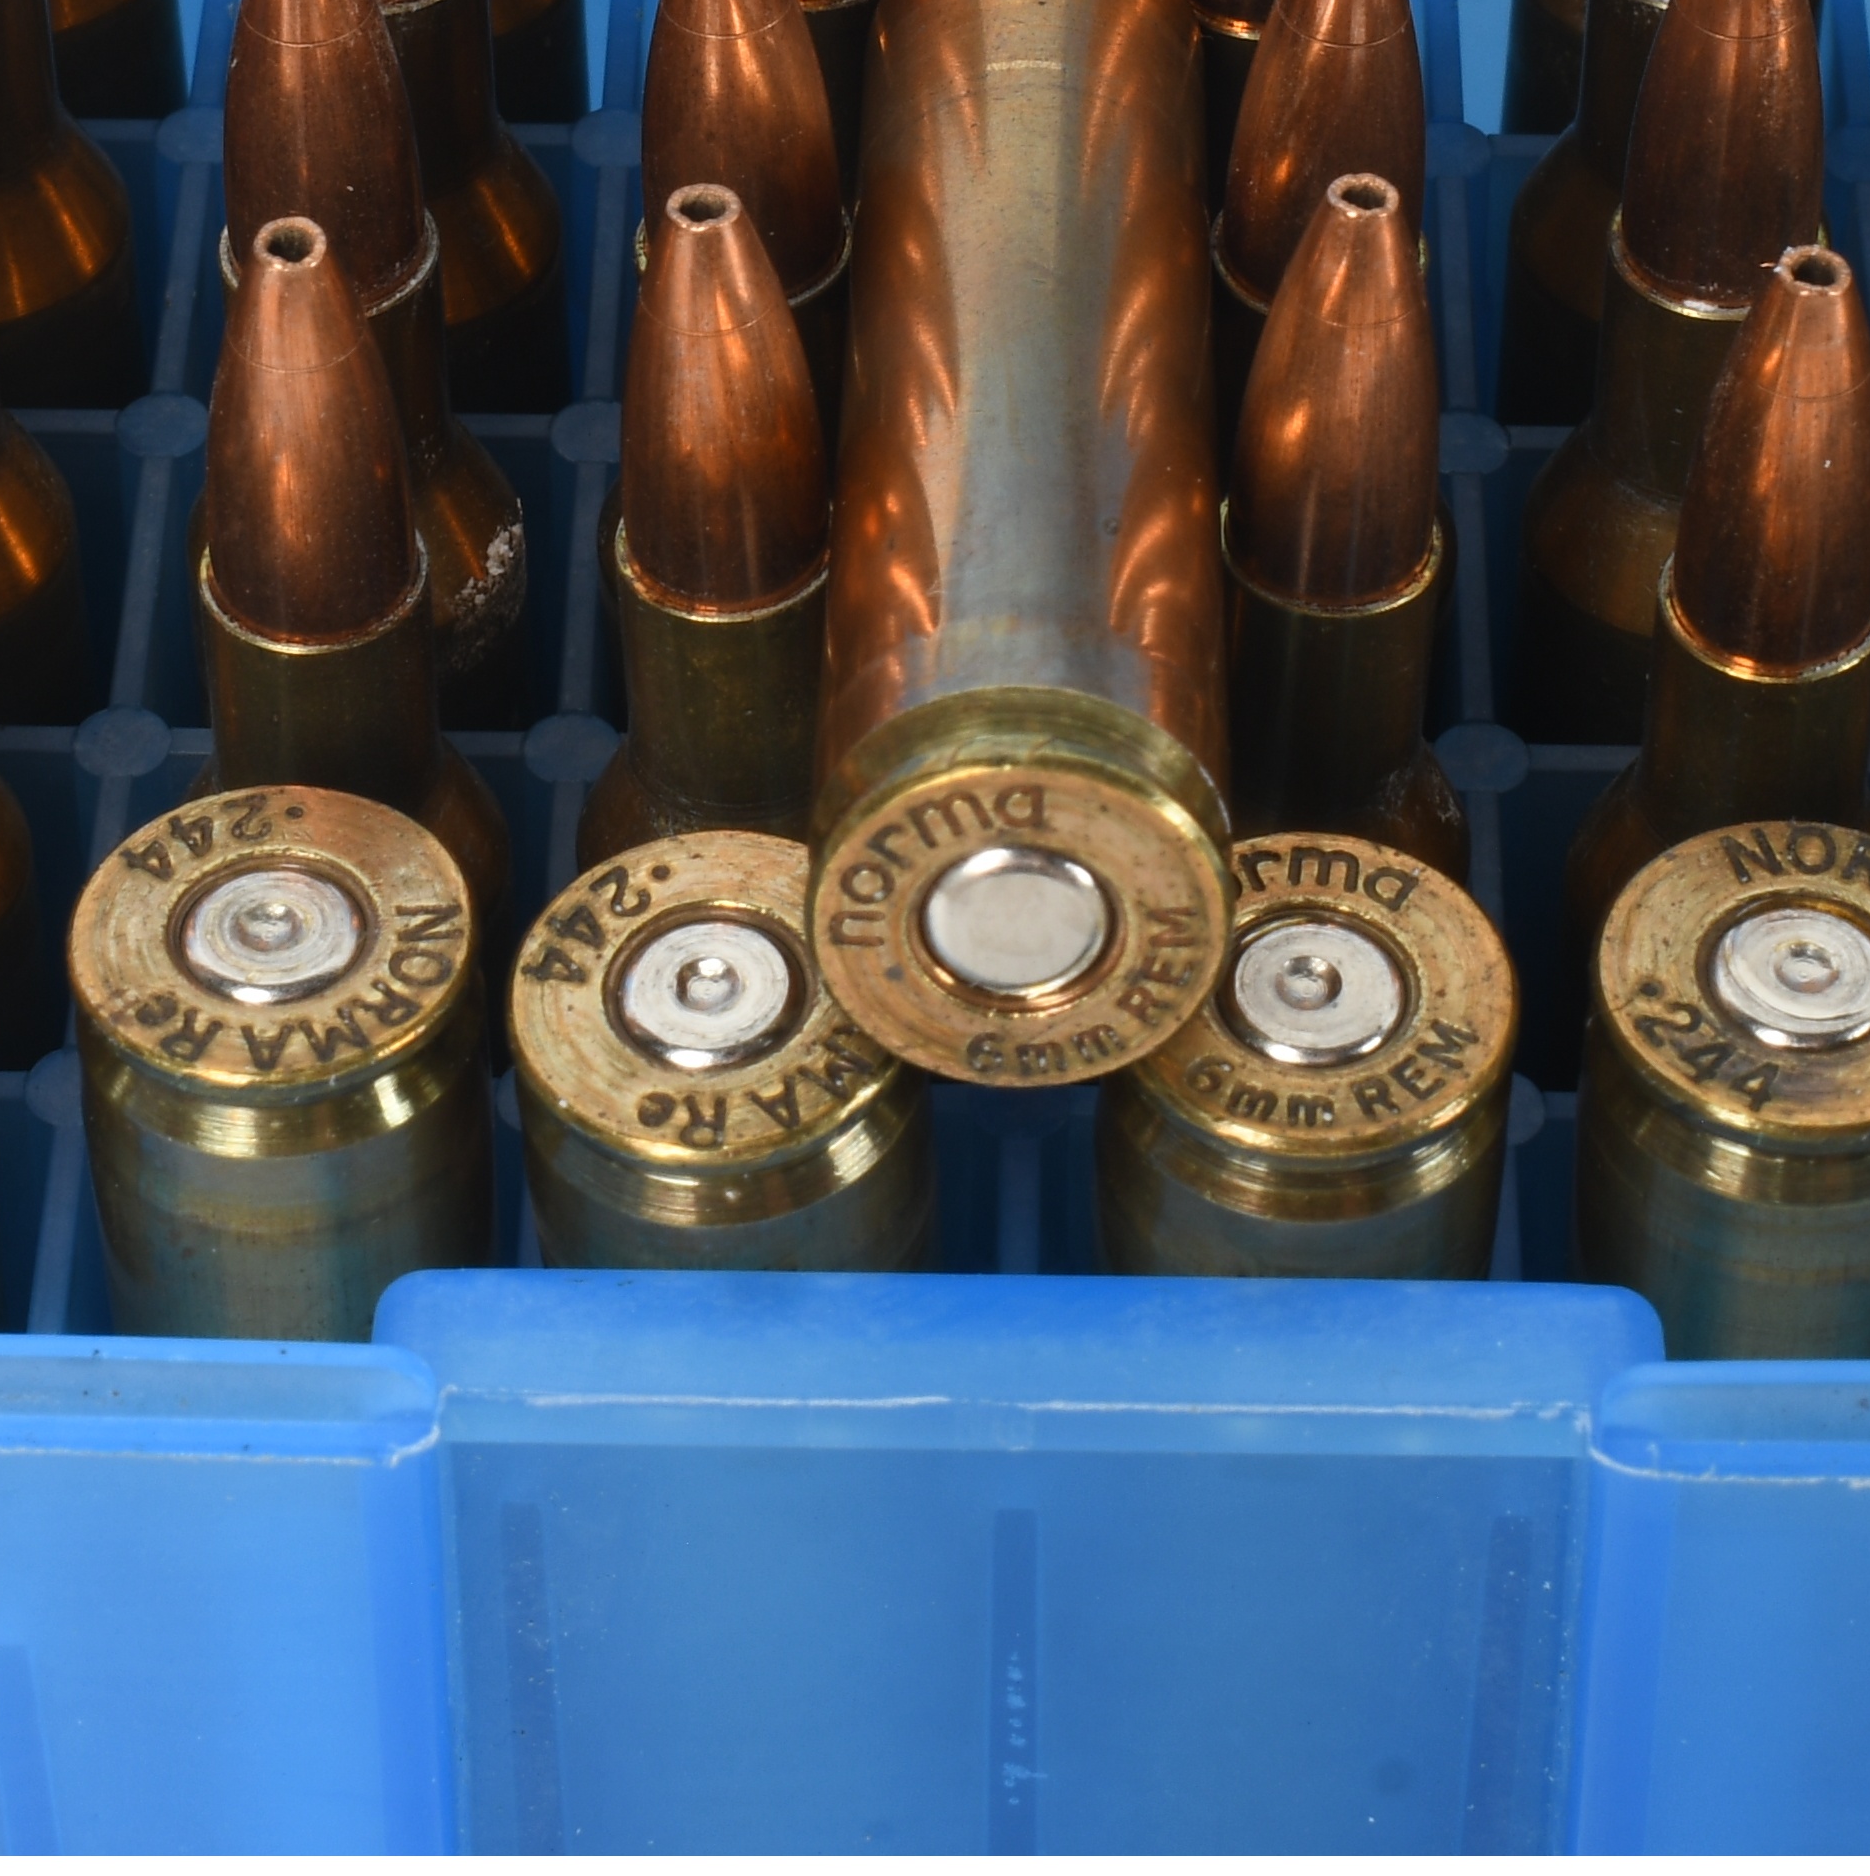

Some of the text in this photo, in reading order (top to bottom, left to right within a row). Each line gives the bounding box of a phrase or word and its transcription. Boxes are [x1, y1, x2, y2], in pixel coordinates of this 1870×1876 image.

[119, 792, 305, 883] .244
[829, 783, 1049, 950] norma
[1231, 844, 1421, 914] rma
[240, 901, 465, 1073] NORMA
[520, 862, 673, 986] .244
[964, 1023, 1129, 1078] 6mm
[1116, 904, 1200, 1026] REM
[1634, 978, 1781, 1113] .244
[1184, 1016, 1481, 1129] 6mm REM
